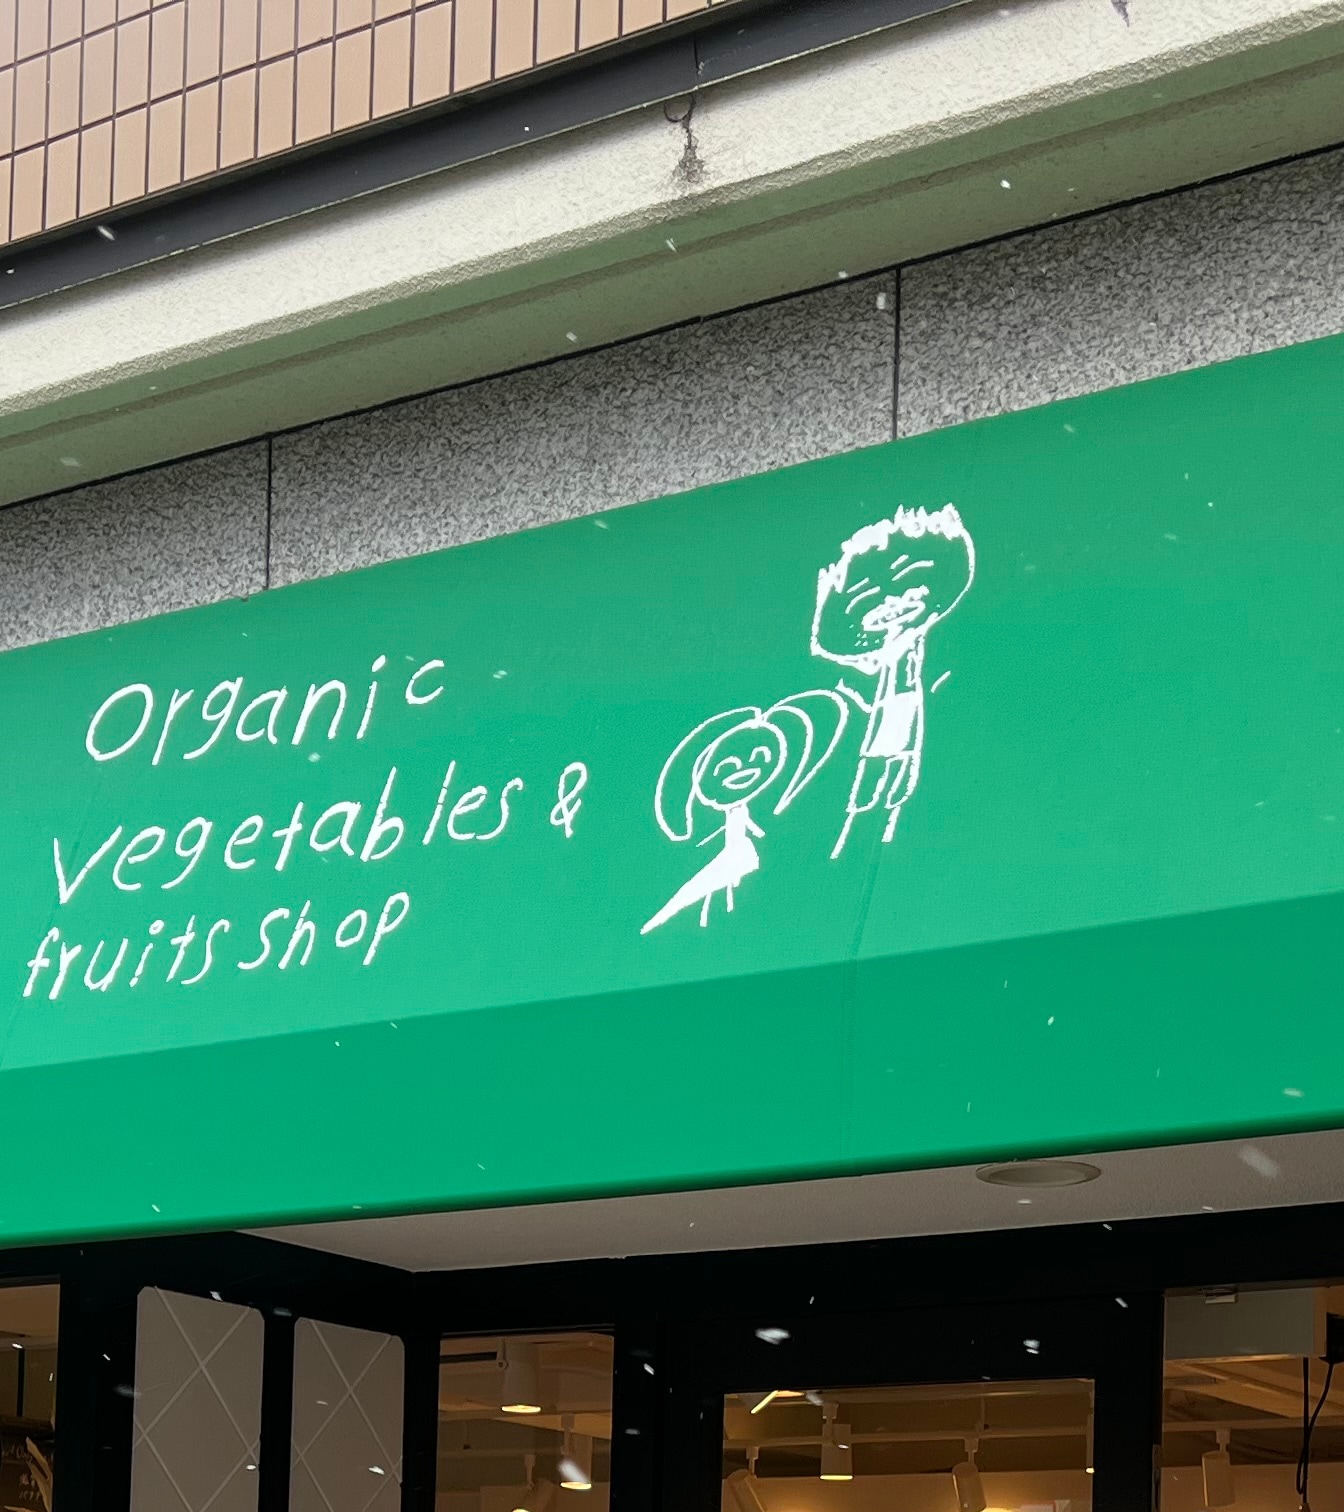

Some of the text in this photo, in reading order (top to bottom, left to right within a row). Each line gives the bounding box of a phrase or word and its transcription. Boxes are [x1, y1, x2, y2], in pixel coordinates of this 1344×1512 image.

[85, 654, 444, 765] Organic
[549, 762, 588, 839] &
[22, 914, 229, 1000] fruits
